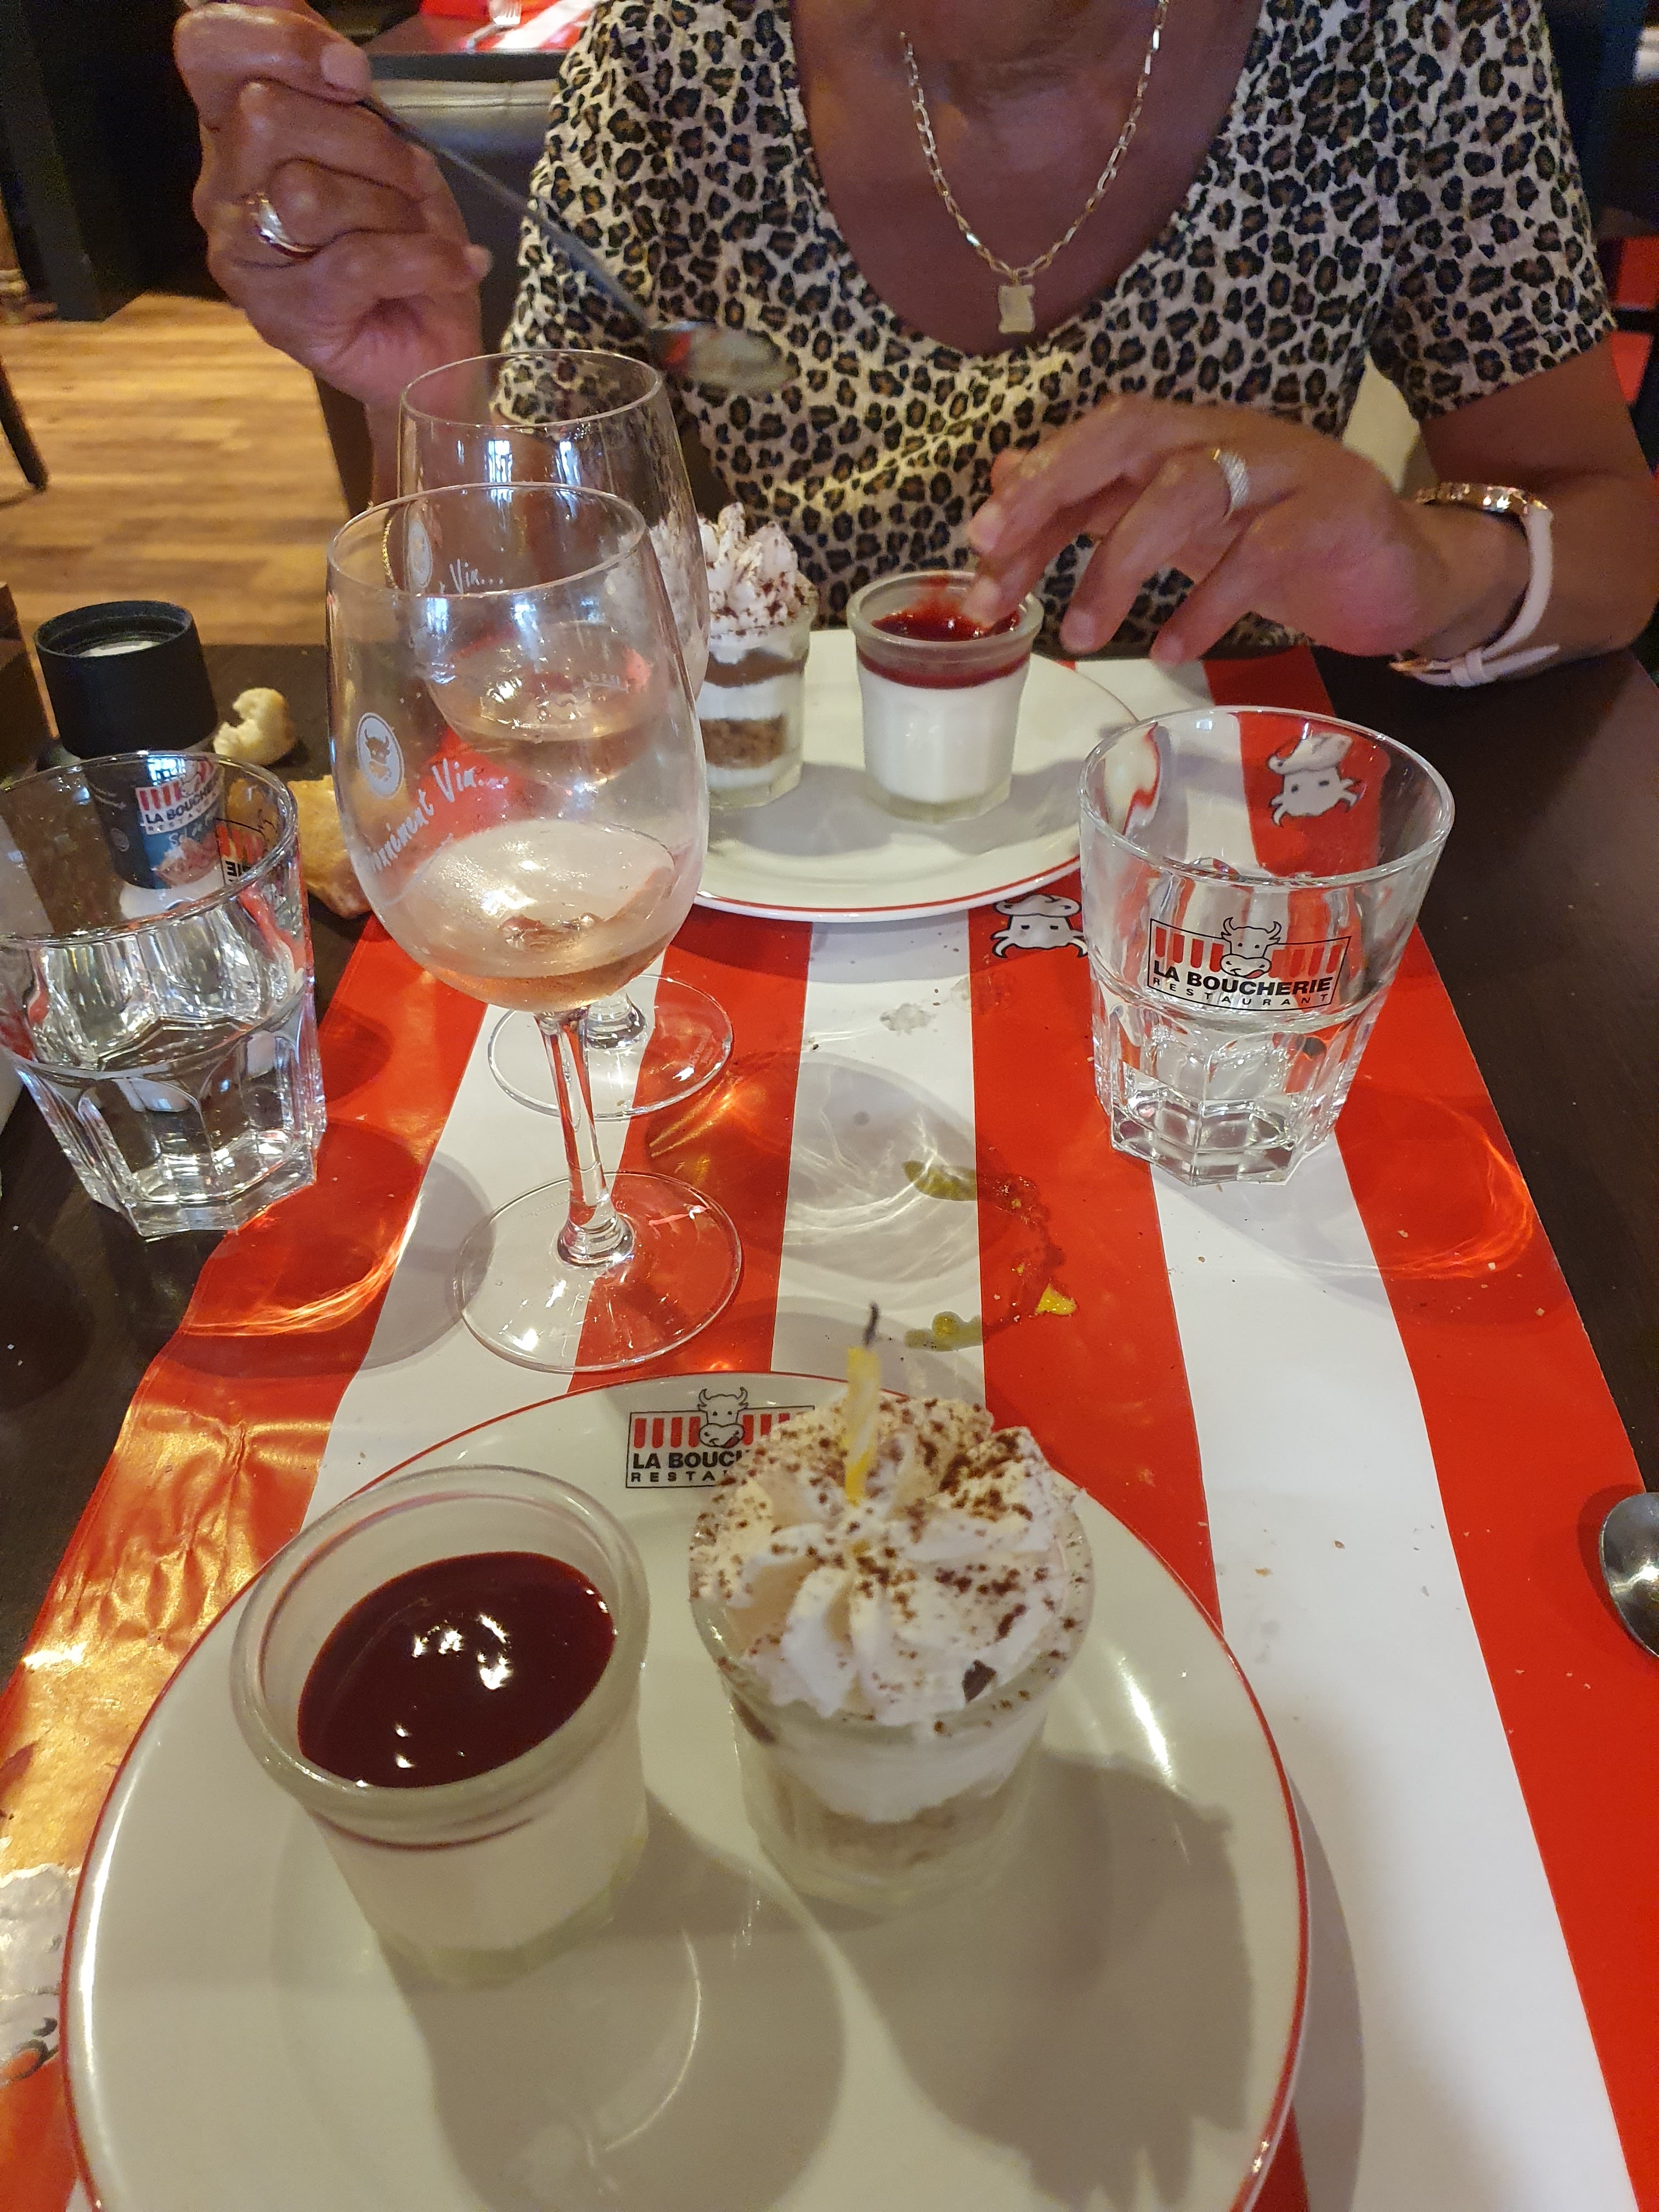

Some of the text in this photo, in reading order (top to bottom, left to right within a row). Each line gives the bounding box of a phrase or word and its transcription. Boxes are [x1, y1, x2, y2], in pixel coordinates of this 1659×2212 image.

[145, 812, 165, 823] LA
[1153, 960, 1333, 996] LA BOUCHERIE
[1153, 977, 1331, 1006] RESTAURANT
[633, 1452, 661, 1469] LA
[631, 1470, 727, 1482] RESTA
